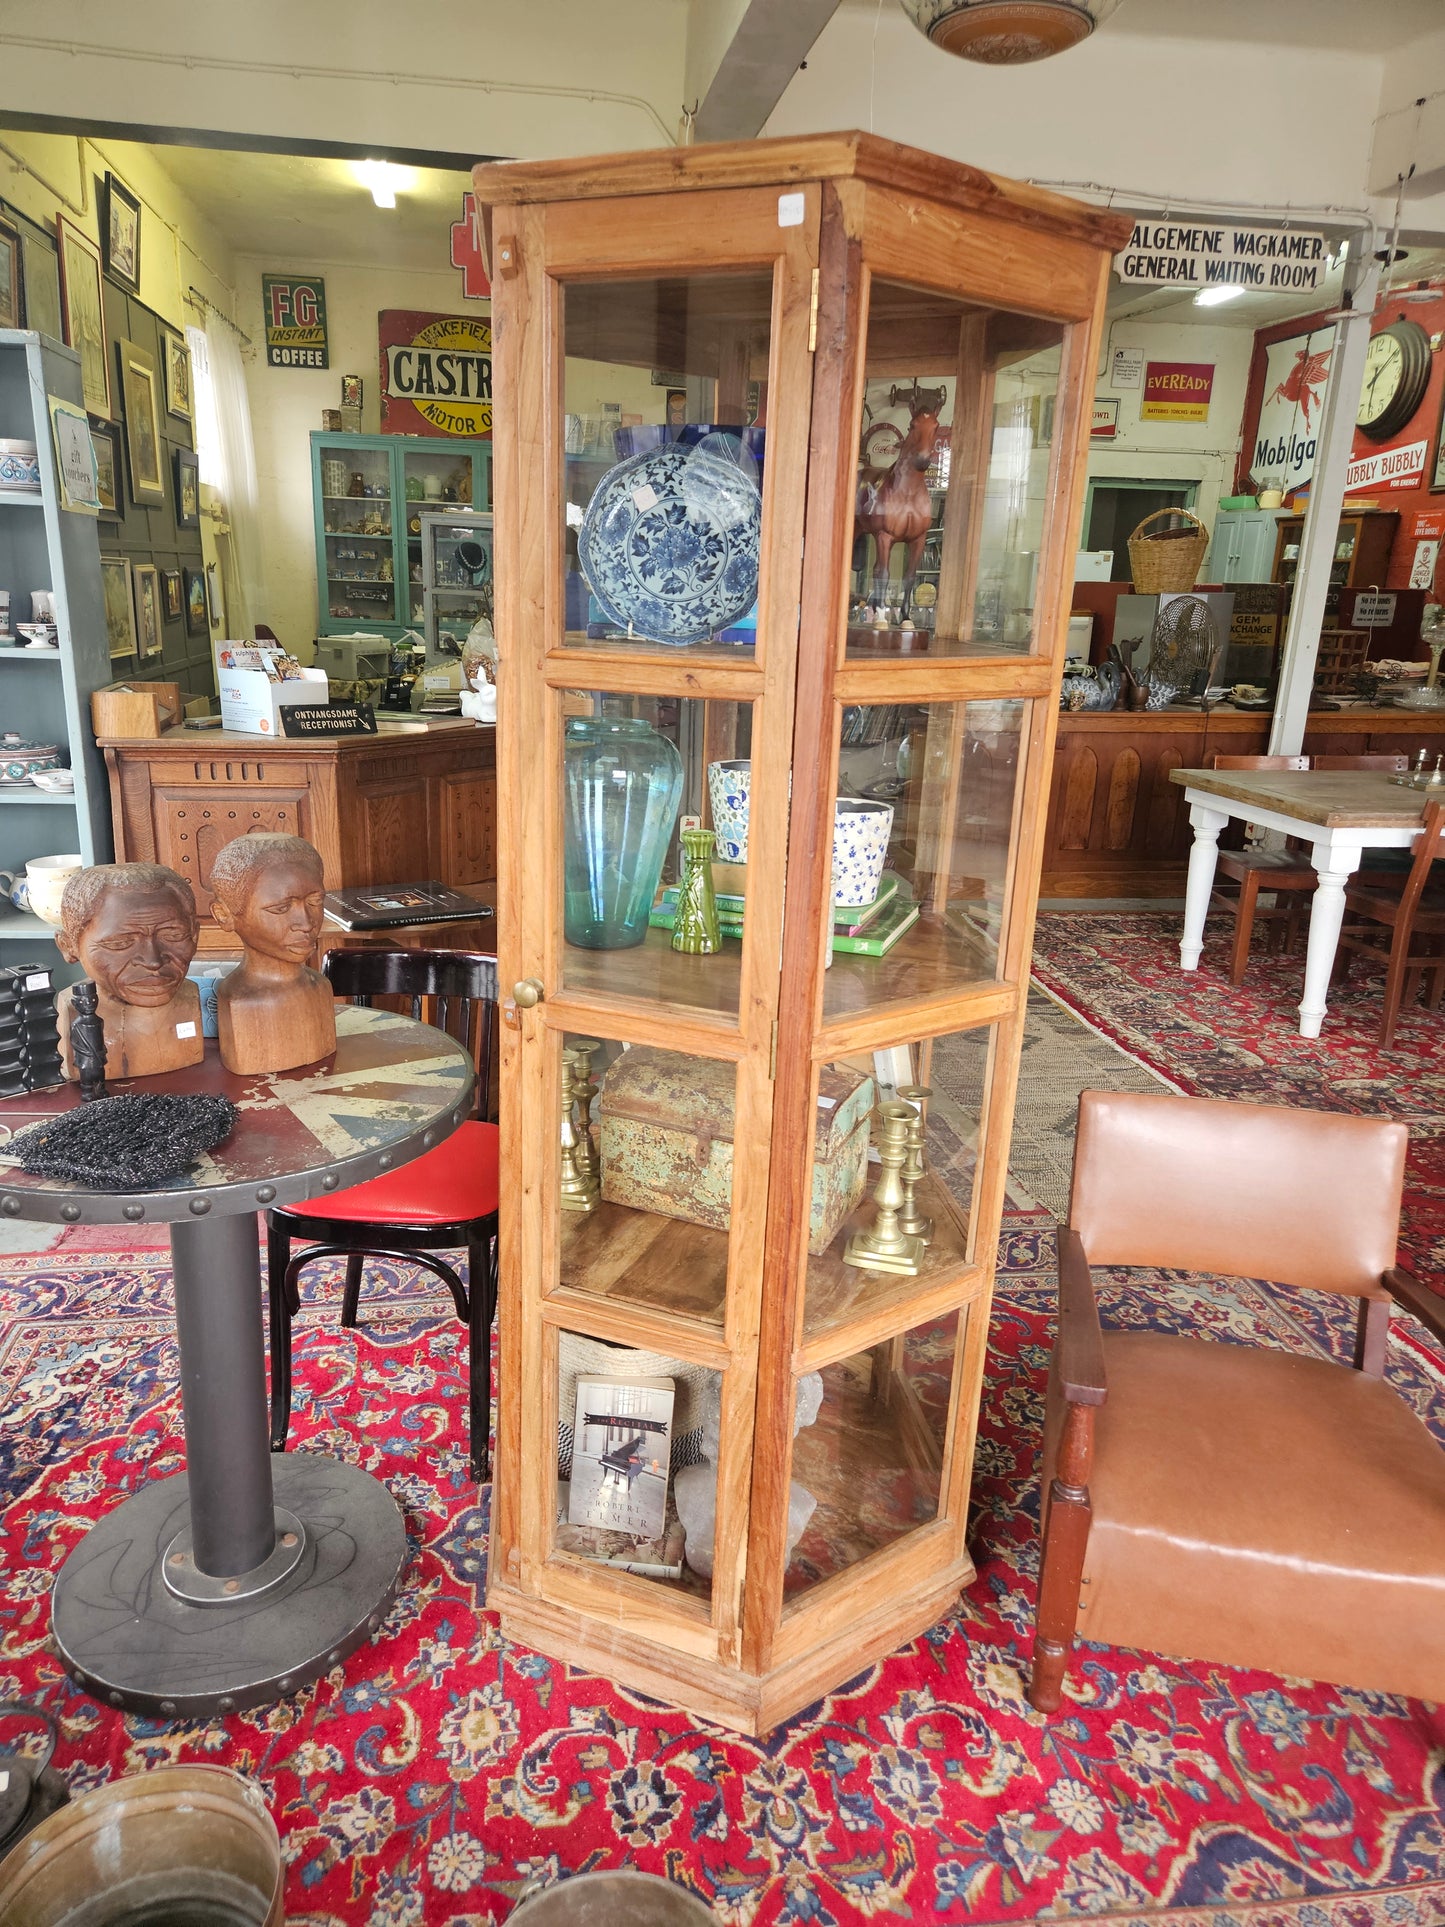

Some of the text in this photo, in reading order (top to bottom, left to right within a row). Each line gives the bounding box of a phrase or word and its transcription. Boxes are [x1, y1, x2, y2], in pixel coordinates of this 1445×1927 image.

[1129, 225, 1328, 260] ALGEMENE WAGKAMER.
[1123, 255, 1317, 288] GENERAL WAITING ROOM.
[270, 285, 319, 328] FG
[271, 328, 323, 341] INSTANT
[421, 321, 492, 347] WAKEFIEL
[272, 348, 323, 366] COFFEE
[1147, 374, 1211, 391] EVEREADY
[423, 403, 476, 432] MOTOR
[1381, 449, 1423, 476] BUBBLY
[1236, 615, 1260, 624] GEM
[295, 708, 358, 720] ONTVANGSDAME
[301, 719, 357, 730] RECEPTIONIST
[610, 1417, 654, 1430] RECITAL
[595, 1500, 639, 1513] ROBERT
[586, 1511, 647, 1528] ELMER
